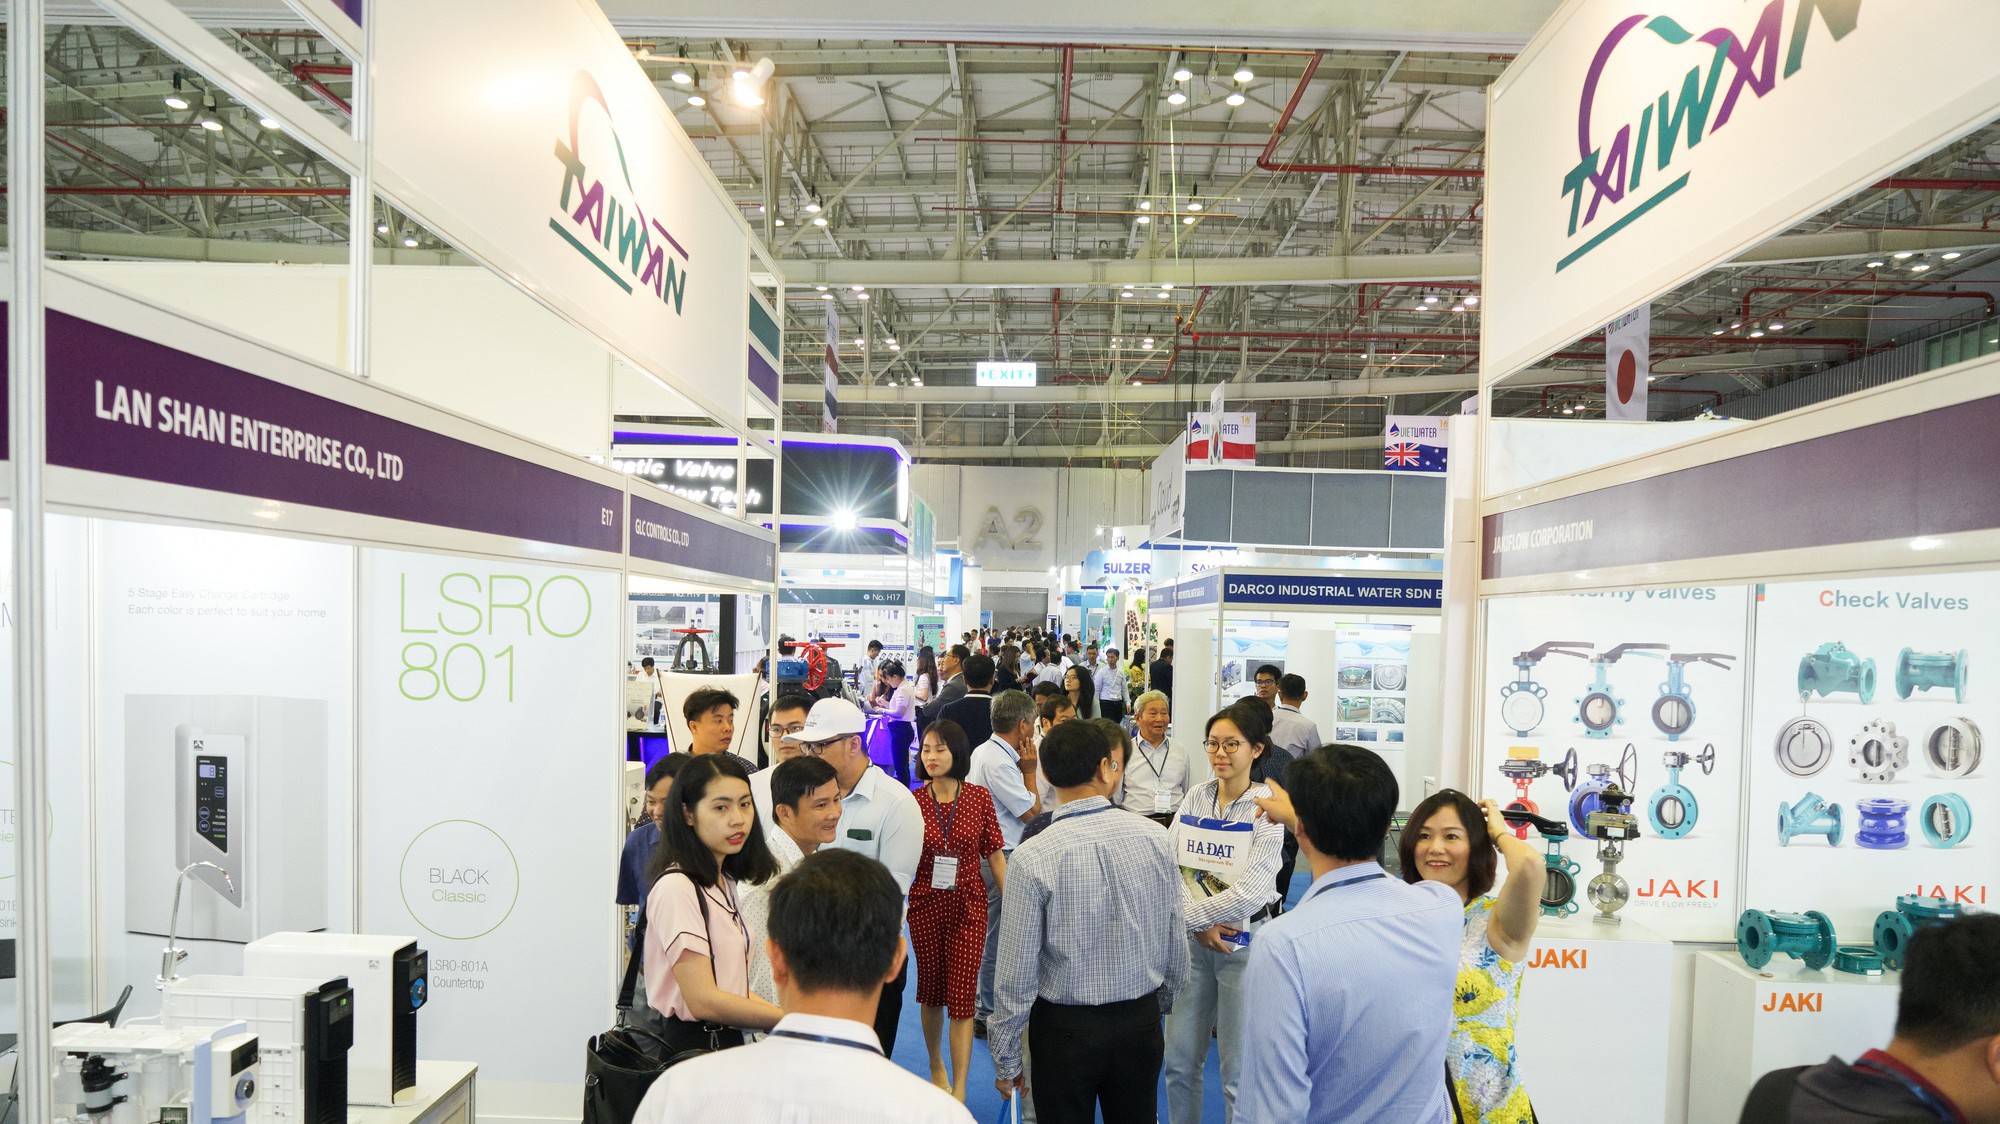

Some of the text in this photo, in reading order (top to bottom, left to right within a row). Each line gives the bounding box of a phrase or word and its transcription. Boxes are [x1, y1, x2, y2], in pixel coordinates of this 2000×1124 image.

[554, 137, 686, 317] TAIWAN
[989, 369, 1024, 380] EXIT
[95, 379, 404, 482] LAN SHAN ENTERPRISE CO., LTD
[675, 459, 735, 479] Valve
[601, 507, 614, 526] E17
[635, 518, 646, 536] GLC
[646, 521, 672, 543] CONTROLS
[681, 531, 690, 547] LTD
[973, 505, 1044, 552] A2
[1492, 519, 1594, 554] JAKIFLOW CORPORATION
[1103, 562, 1151, 575] SULZER
[128, 588, 290, 602] 5 Stage Easy Change Cartridge
[1229, 583, 1275, 596] DARCO
[1278, 584, 1354, 598] INDUSTRIAL
[1357, 586, 1402, 599] WATER
[1405, 587, 1432, 600] SDN
[1645, 587, 1716, 601] Valves
[1819, 590, 1969, 610] Check Valves
[128, 604, 327, 619] Each color is perfect to suit your home
[401, 573, 592, 638] LSRO
[399, 641, 514, 702] 801
[429, 868, 489, 885] BLACK
[432, 889, 486, 903] Classic
[1637, 878, 1719, 898] JAKI
[1662, 900, 1684, 908] FLOW
[429, 959, 489, 972] LSRO-801A
[1527, 948, 1587, 969] JAKI
[432, 976, 485, 990] Countertop
[1762, 992, 1822, 1012] JAKI
